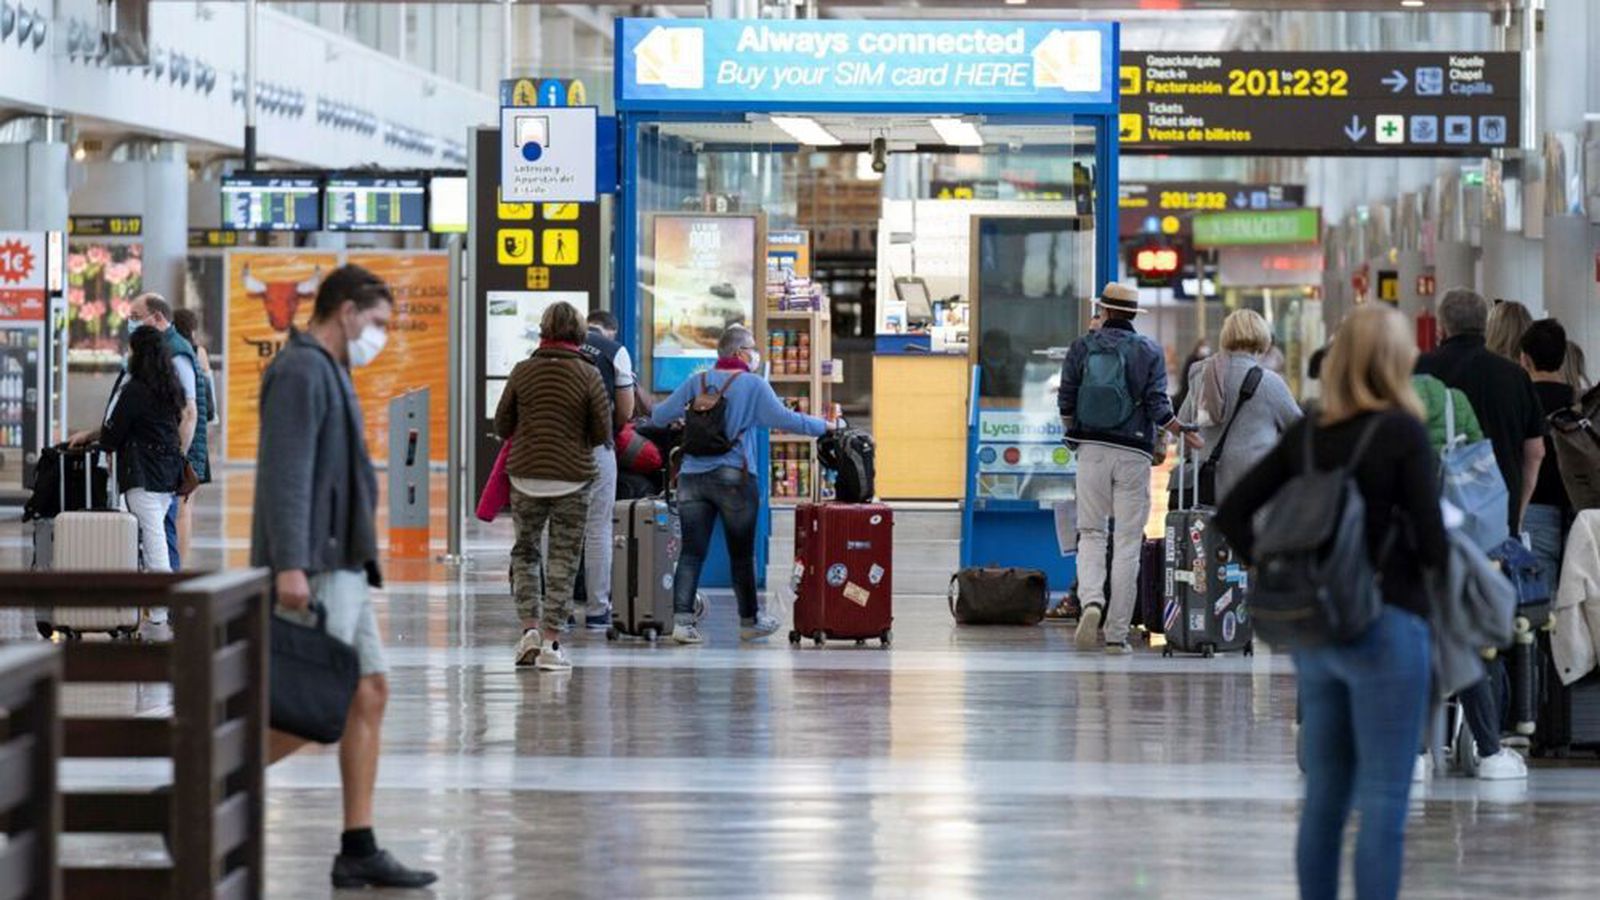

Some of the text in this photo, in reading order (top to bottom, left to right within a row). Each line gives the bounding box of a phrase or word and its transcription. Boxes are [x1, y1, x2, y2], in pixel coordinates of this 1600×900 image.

[737, 26, 1025, 58] Always connected
[1448, 55, 1485, 68] Kapelle
[716, 60, 1030, 90] Buy your SIM card HERE
[1146, 68, 1188, 79] Check-in
[1448, 68, 1483, 81] Chapel
[1146, 80, 1223, 94] Facturación
[1228, 69, 1281, 97] 201
[1292, 69, 1348, 97] 232
[1449, 82, 1494, 96] Capilla
[1147, 102, 1184, 114] Tickets
[1147, 115, 1204, 127] Ticket sales
[1147, 128, 1252, 141] Venta de billetes
